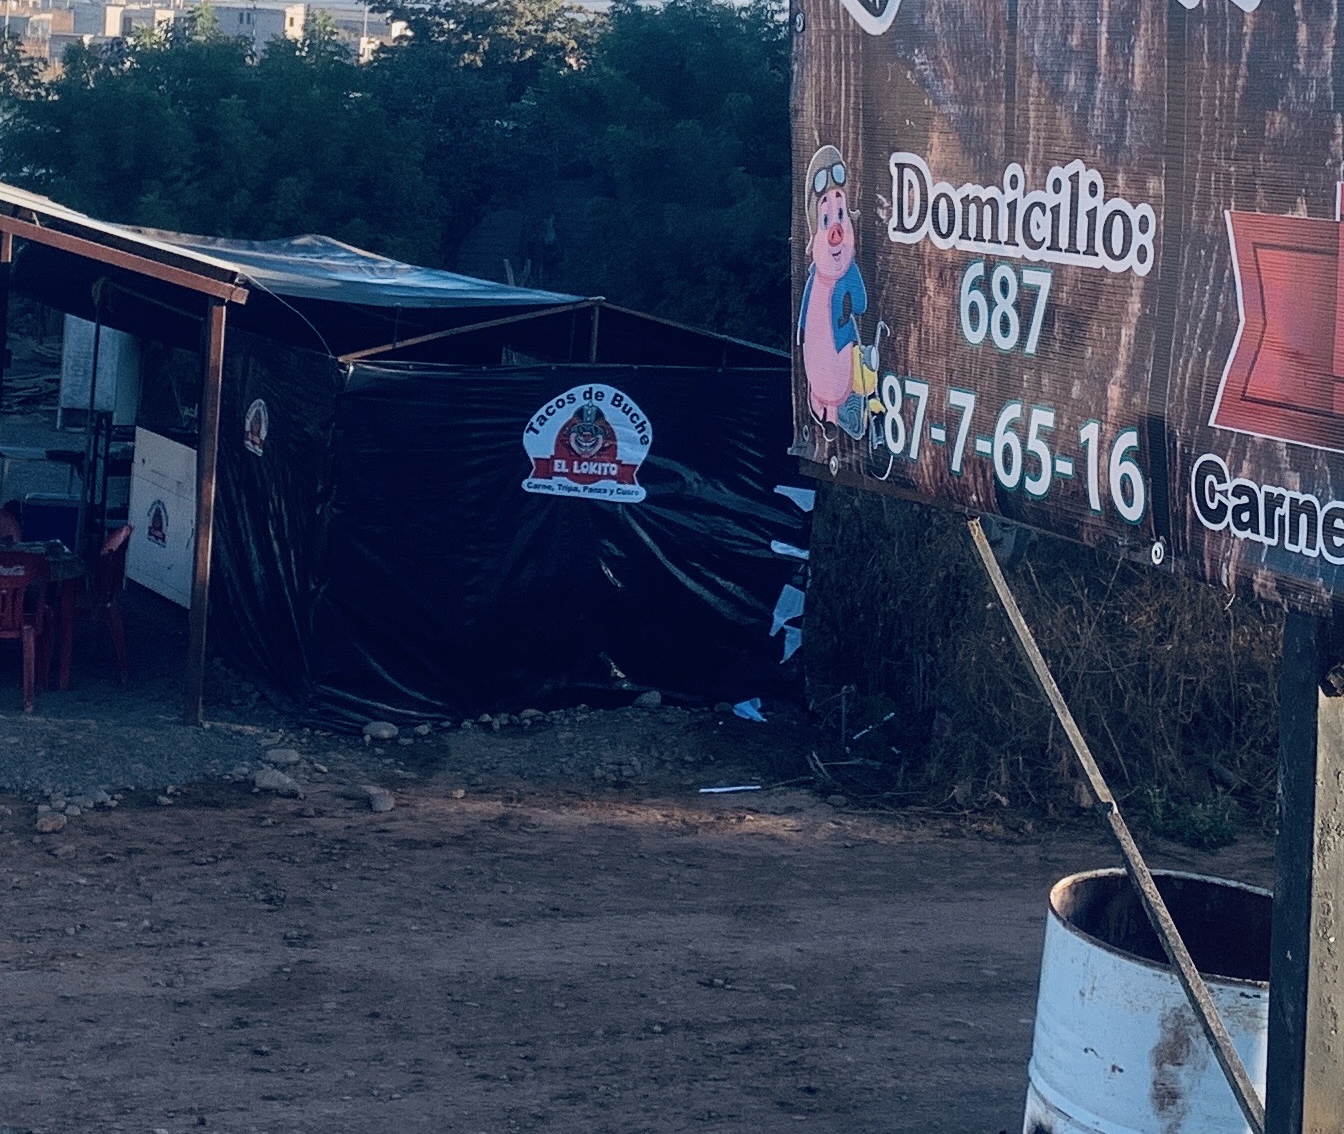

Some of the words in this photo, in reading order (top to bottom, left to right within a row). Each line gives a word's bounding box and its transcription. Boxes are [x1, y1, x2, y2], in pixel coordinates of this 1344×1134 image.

[890, 157, 1155, 271] Domicilio:
[959, 261, 1053, 356] 687
[525, 392, 577, 435] Tacos
[582, 386, 605, 402] de
[610, 391, 650, 446] Buche
[882, 373, 1147, 523] 87-7-65-16
[553, 459, 569, 474] EL
[572, 460, 619, 476] LOKITO
